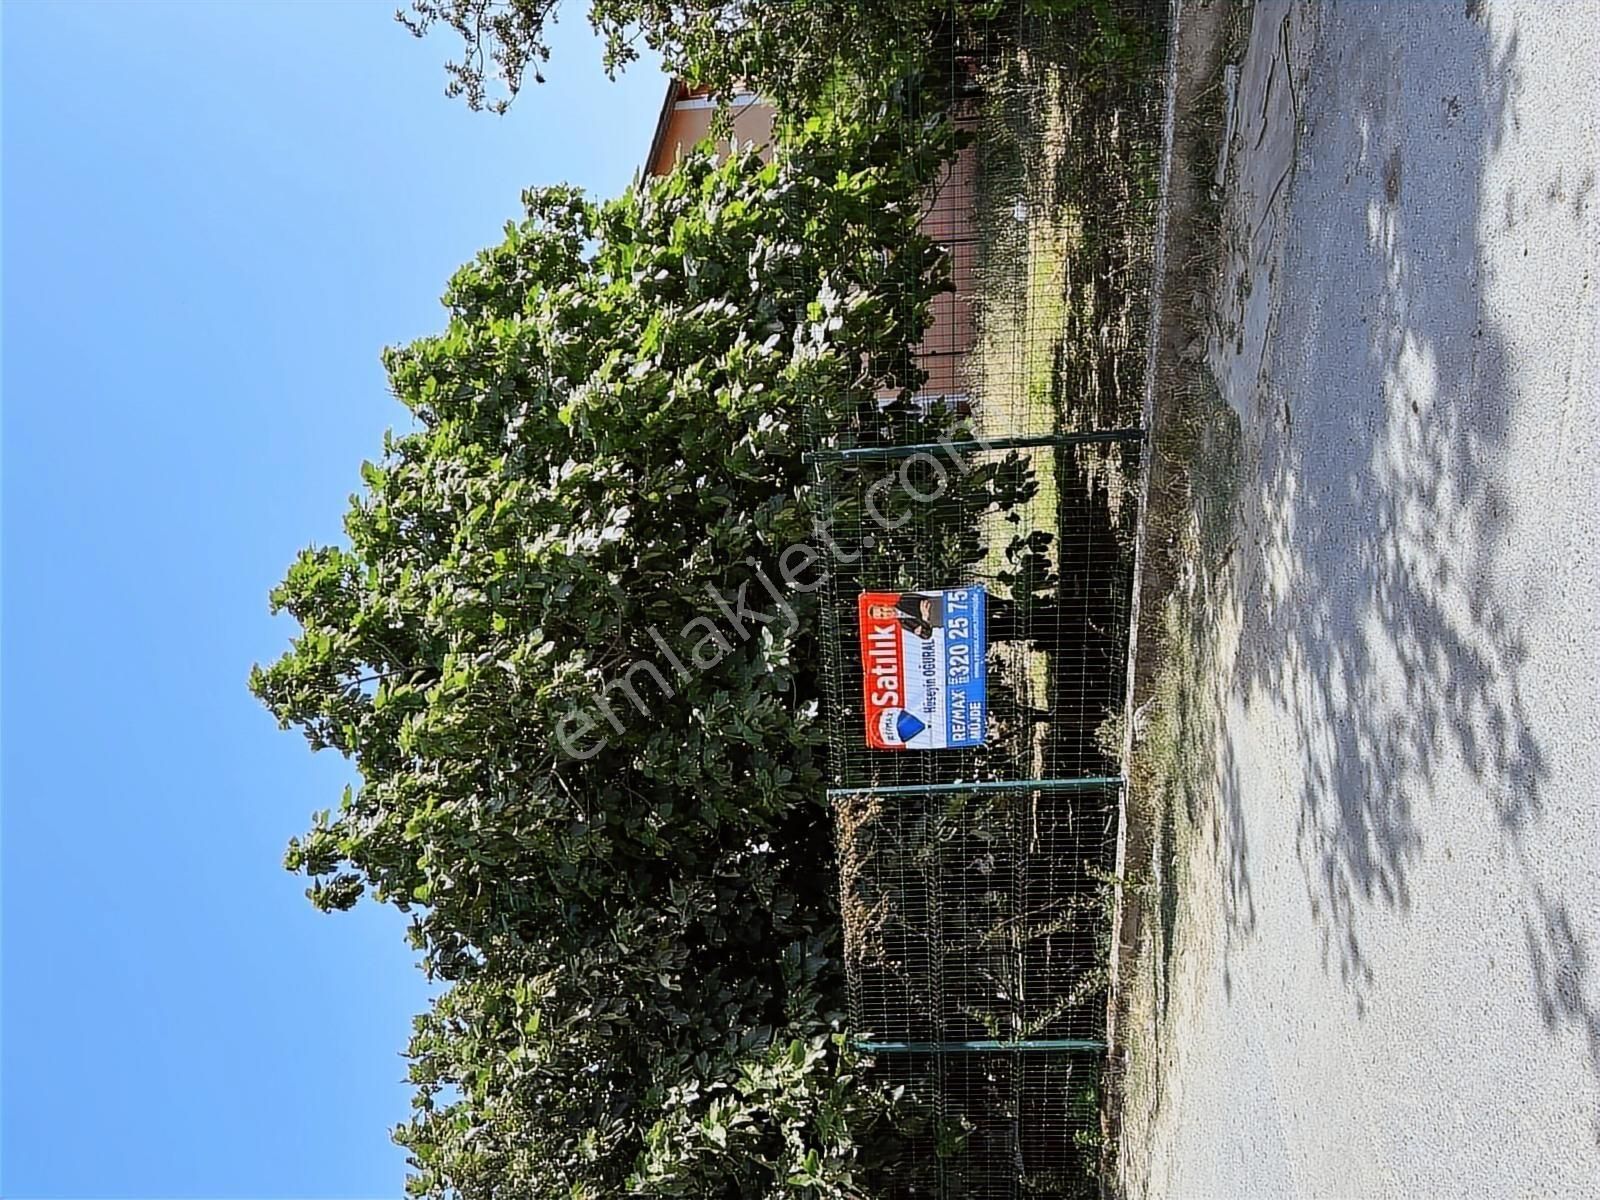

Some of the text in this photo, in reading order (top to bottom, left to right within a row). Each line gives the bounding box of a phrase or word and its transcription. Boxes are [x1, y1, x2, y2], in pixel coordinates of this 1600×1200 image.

[948, 592, 968, 612] 75
[948, 618, 968, 639] 25
[868, 623, 898, 706] Satılık
[919, 639, 939, 713] Hüseyin OĞURAL
[948, 645, 969, 675] 320
[885, 712, 896, 741] RE/MAX
[951, 690, 966, 741] RE/MAX
[967, 702, 981, 739] MÜJDE
